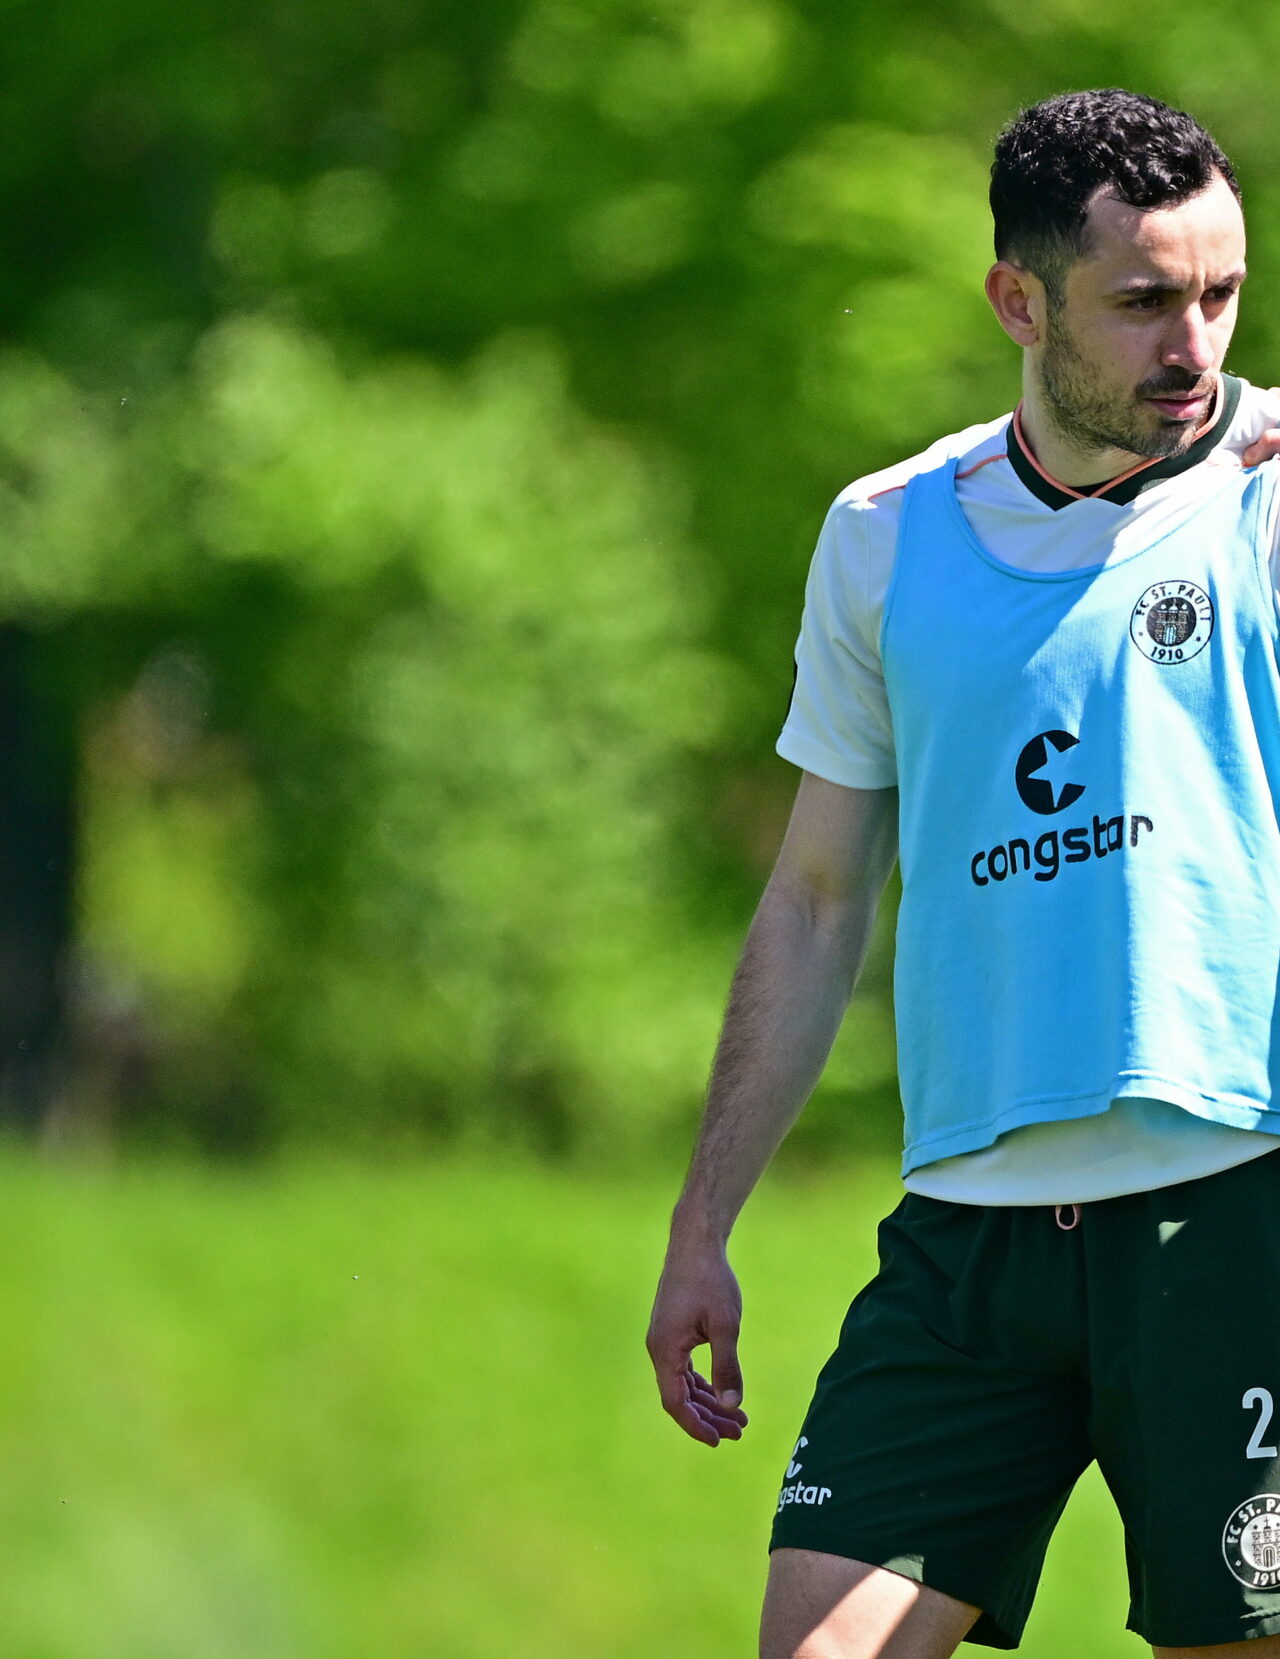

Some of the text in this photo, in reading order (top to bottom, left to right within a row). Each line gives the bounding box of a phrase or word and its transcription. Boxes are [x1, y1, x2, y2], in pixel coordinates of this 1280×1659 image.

[1135, 584, 1211, 621] FC ST. PAULI
[1151, 646, 1184, 661] 1910
[971, 814, 1154, 886] congstar
[1242, 1387, 1278, 1459] 2
[1226, 1524, 1242, 1544] FC
[1238, 1503, 1262, 1523] ST.
